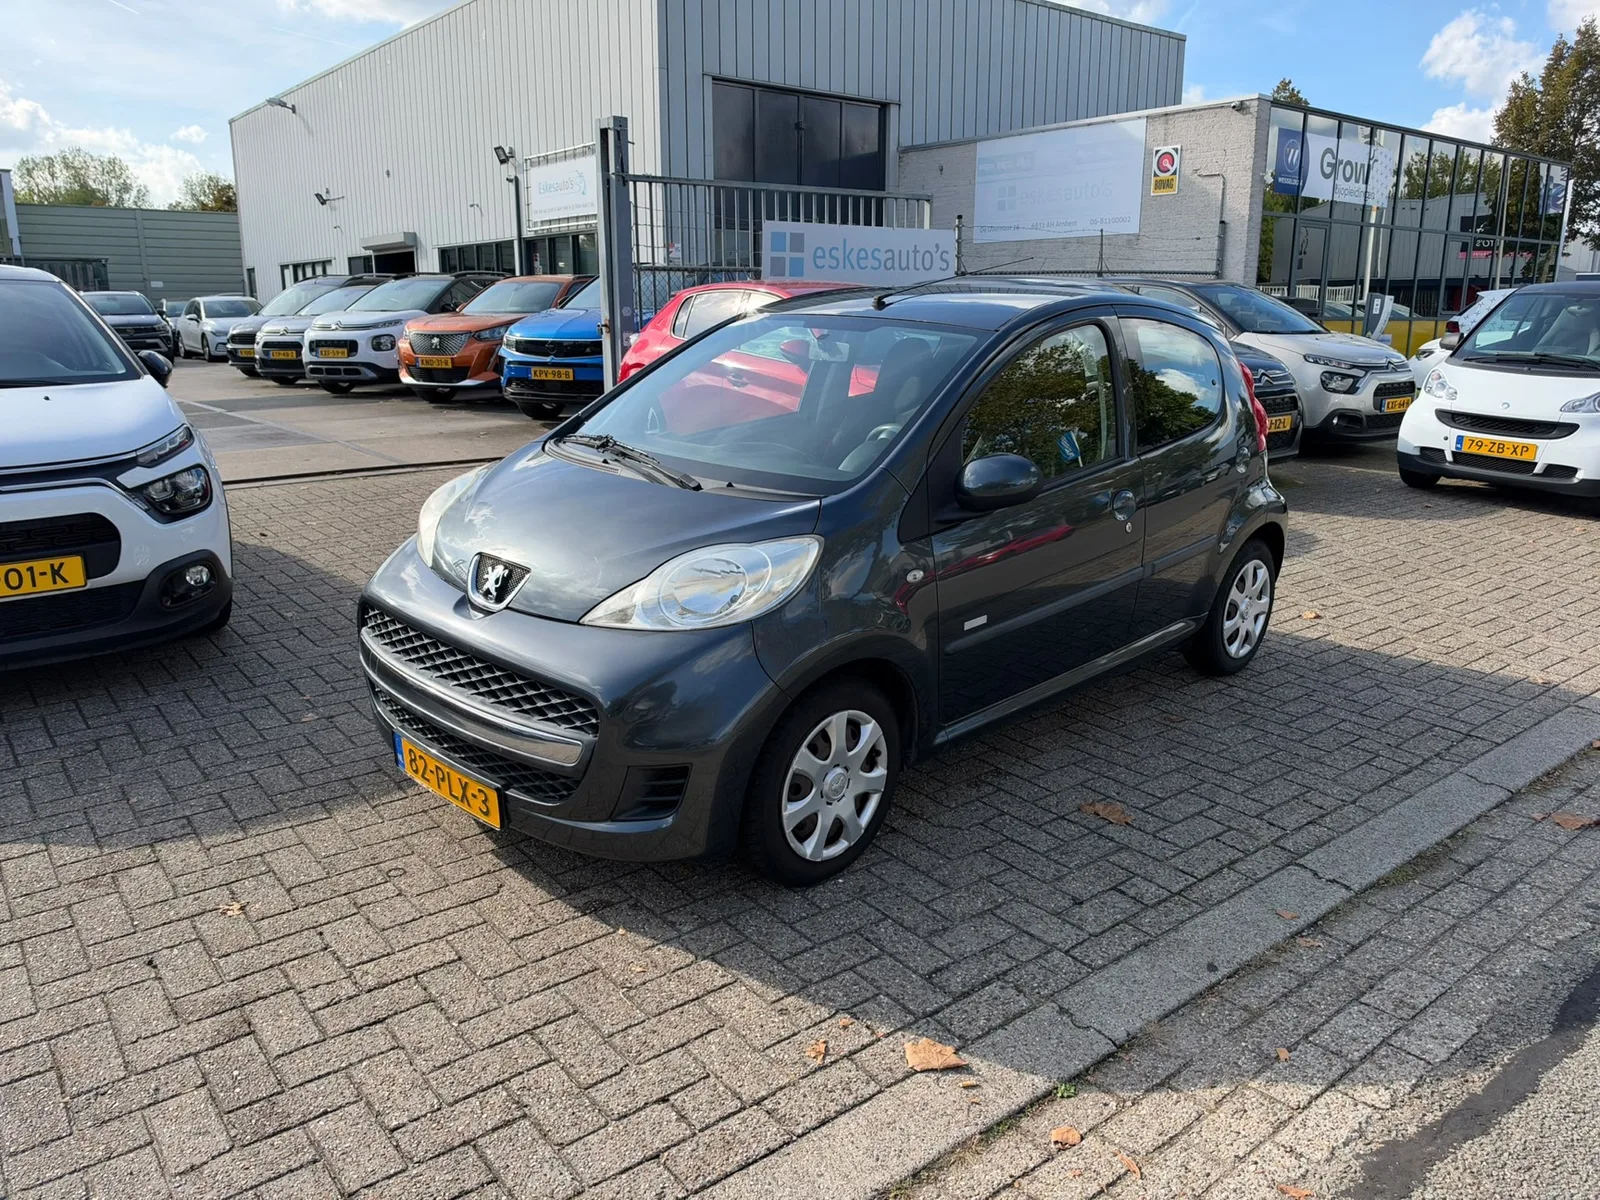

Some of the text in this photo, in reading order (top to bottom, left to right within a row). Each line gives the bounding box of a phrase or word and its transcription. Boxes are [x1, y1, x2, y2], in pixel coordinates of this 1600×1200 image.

[1154, 178, 1174, 190] BOVAG
[812, 238, 950, 272] eskesauto's
[533, 369, 571, 379] KPV-98-B
[1467, 439, 1530, 457] 79-ZB-XP
[1, 562, 70, 590] 01-K
[408, 748, 490, 817] 82-PLX-3
